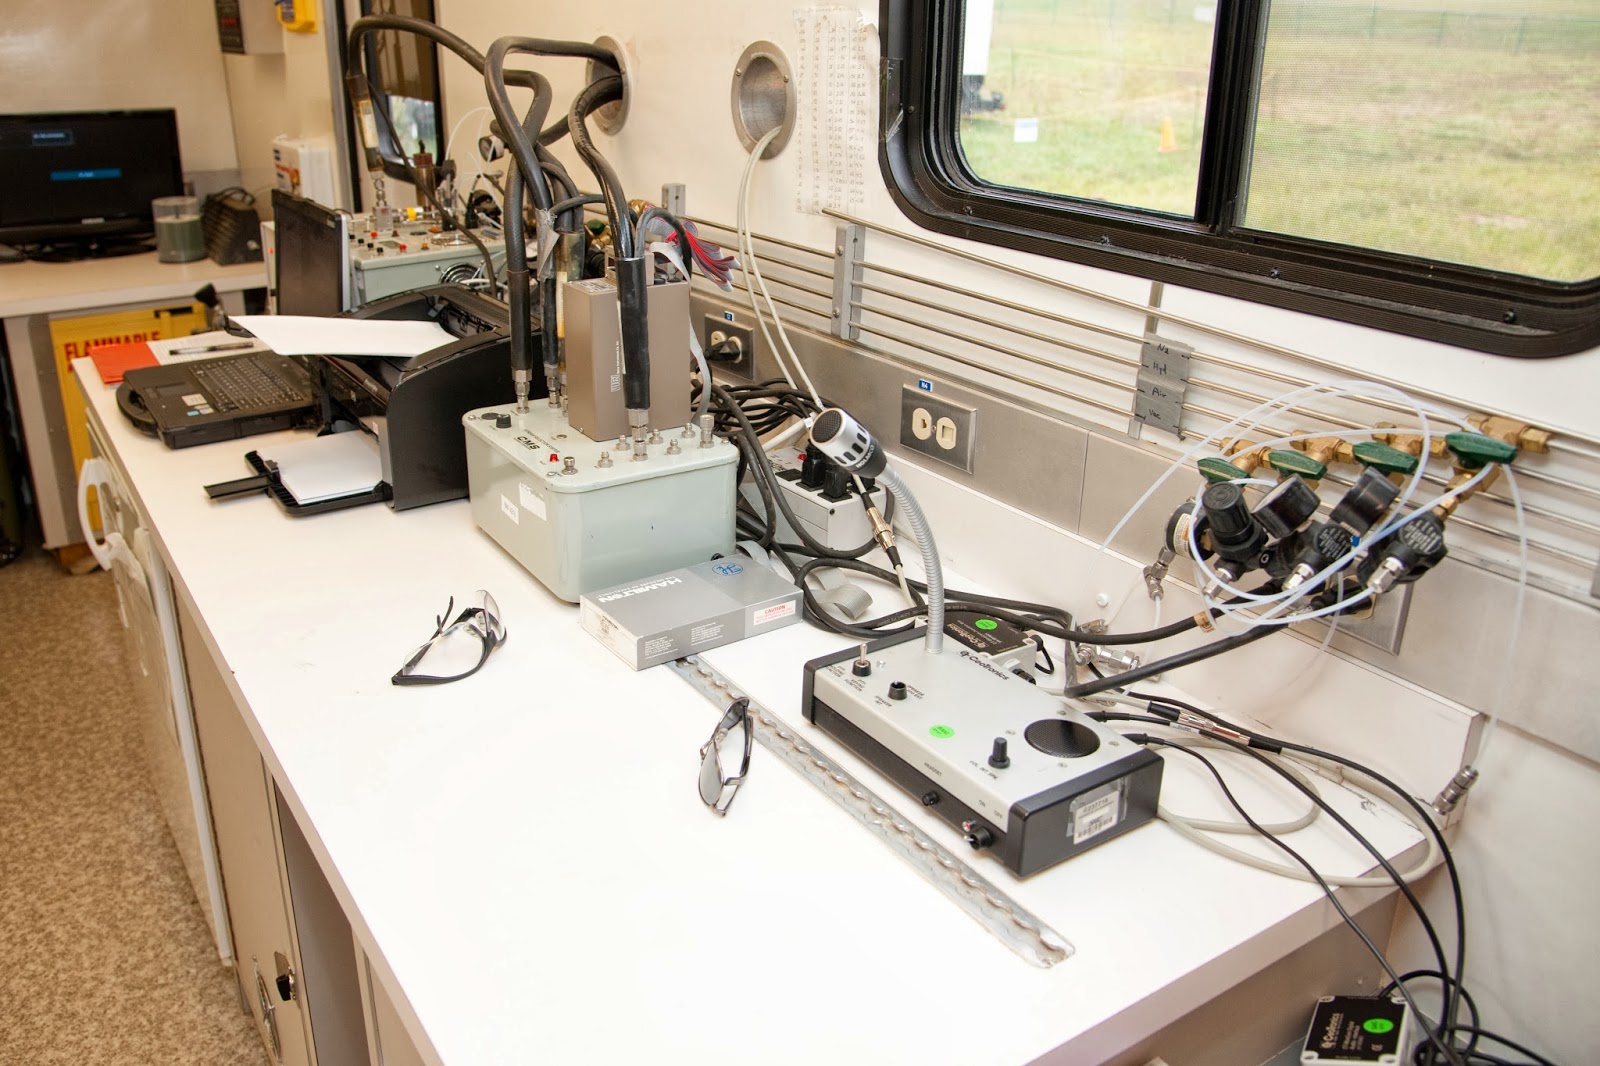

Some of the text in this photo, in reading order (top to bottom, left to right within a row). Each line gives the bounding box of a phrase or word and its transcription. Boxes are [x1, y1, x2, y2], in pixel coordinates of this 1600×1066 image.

[1152, 387, 1166, 398] Air
[517, 436, 540, 450] CMS
[855, 444, 875, 468] HOLMCO
[598, 577, 682, 603] HAMILTON
[765, 605, 785, 614] CAUTION
